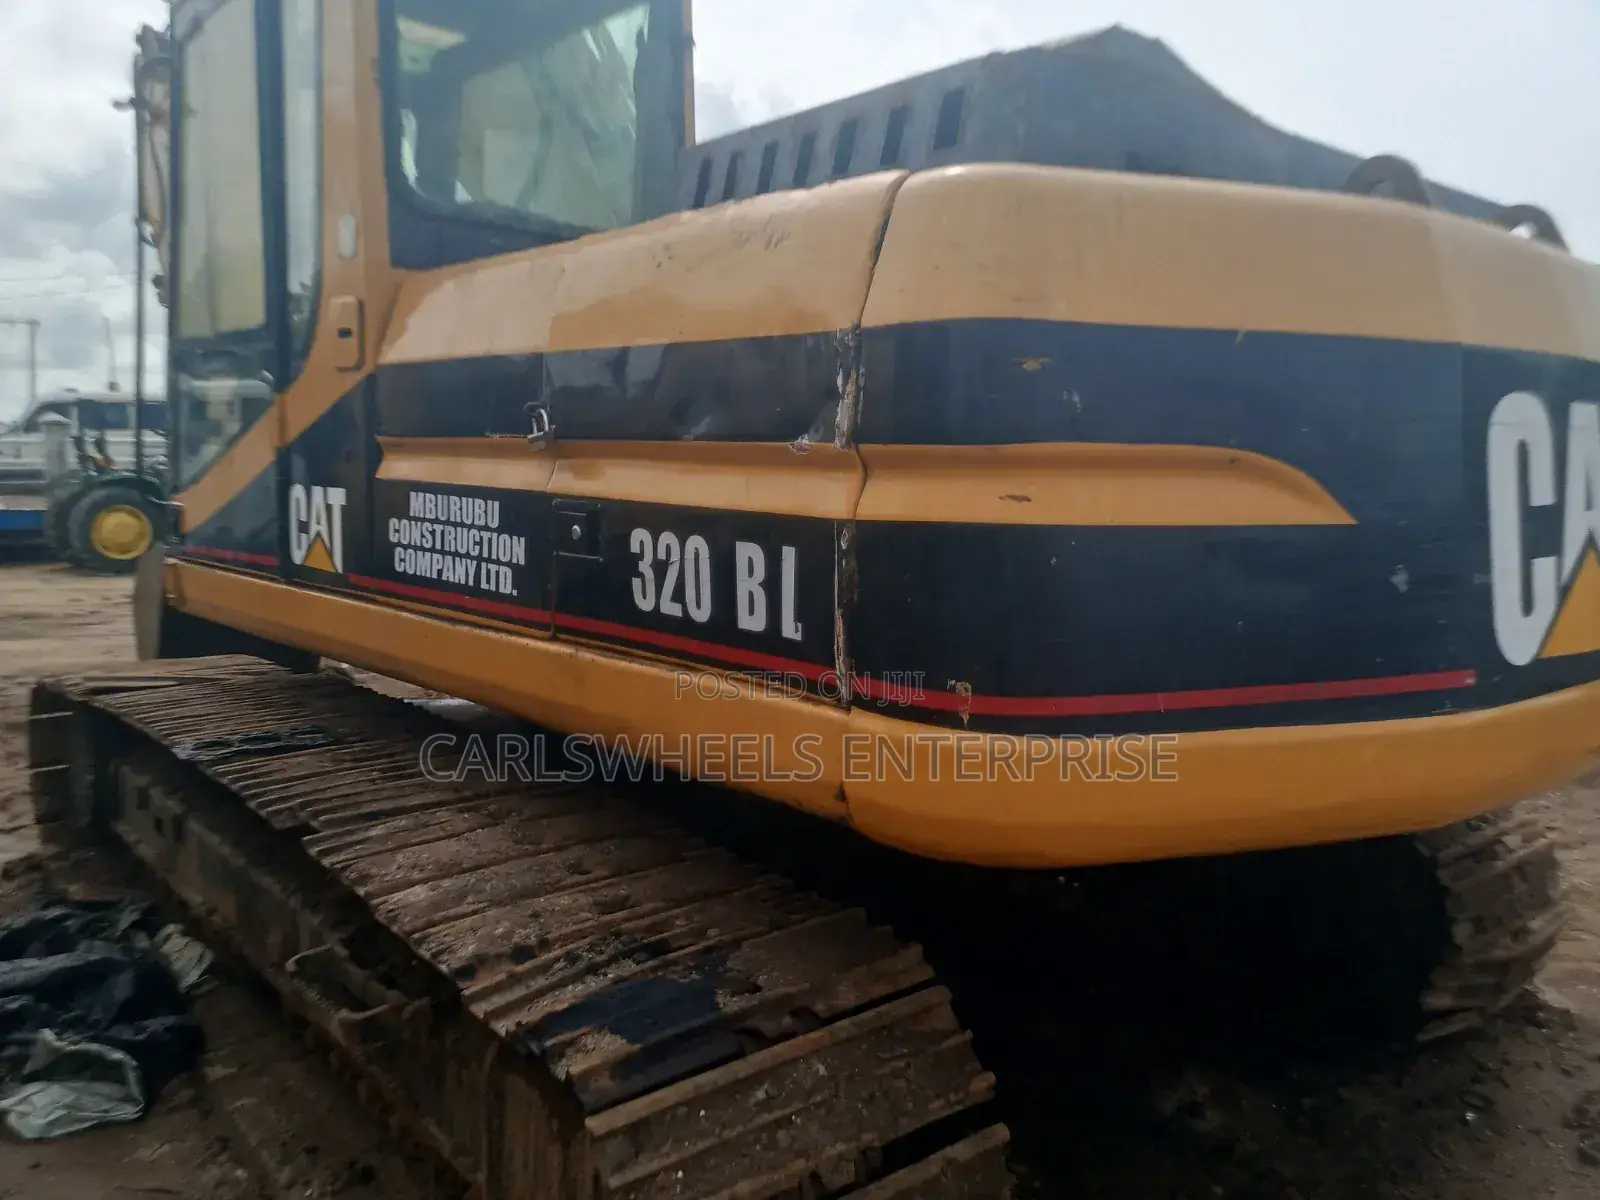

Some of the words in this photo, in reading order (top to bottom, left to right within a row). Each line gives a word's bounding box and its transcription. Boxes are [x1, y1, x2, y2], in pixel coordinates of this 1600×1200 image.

[288, 483, 347, 574] CAT
[409, 491, 500, 528] MBURUBU
[388, 518, 526, 565] CONSTRUCTION
[393, 547, 477, 587] COMPANY
[480, 566, 518, 596] LTD.
[630, 528, 712, 622] 320
[735, 541, 767, 632] B
[781, 545, 802, 641] L
